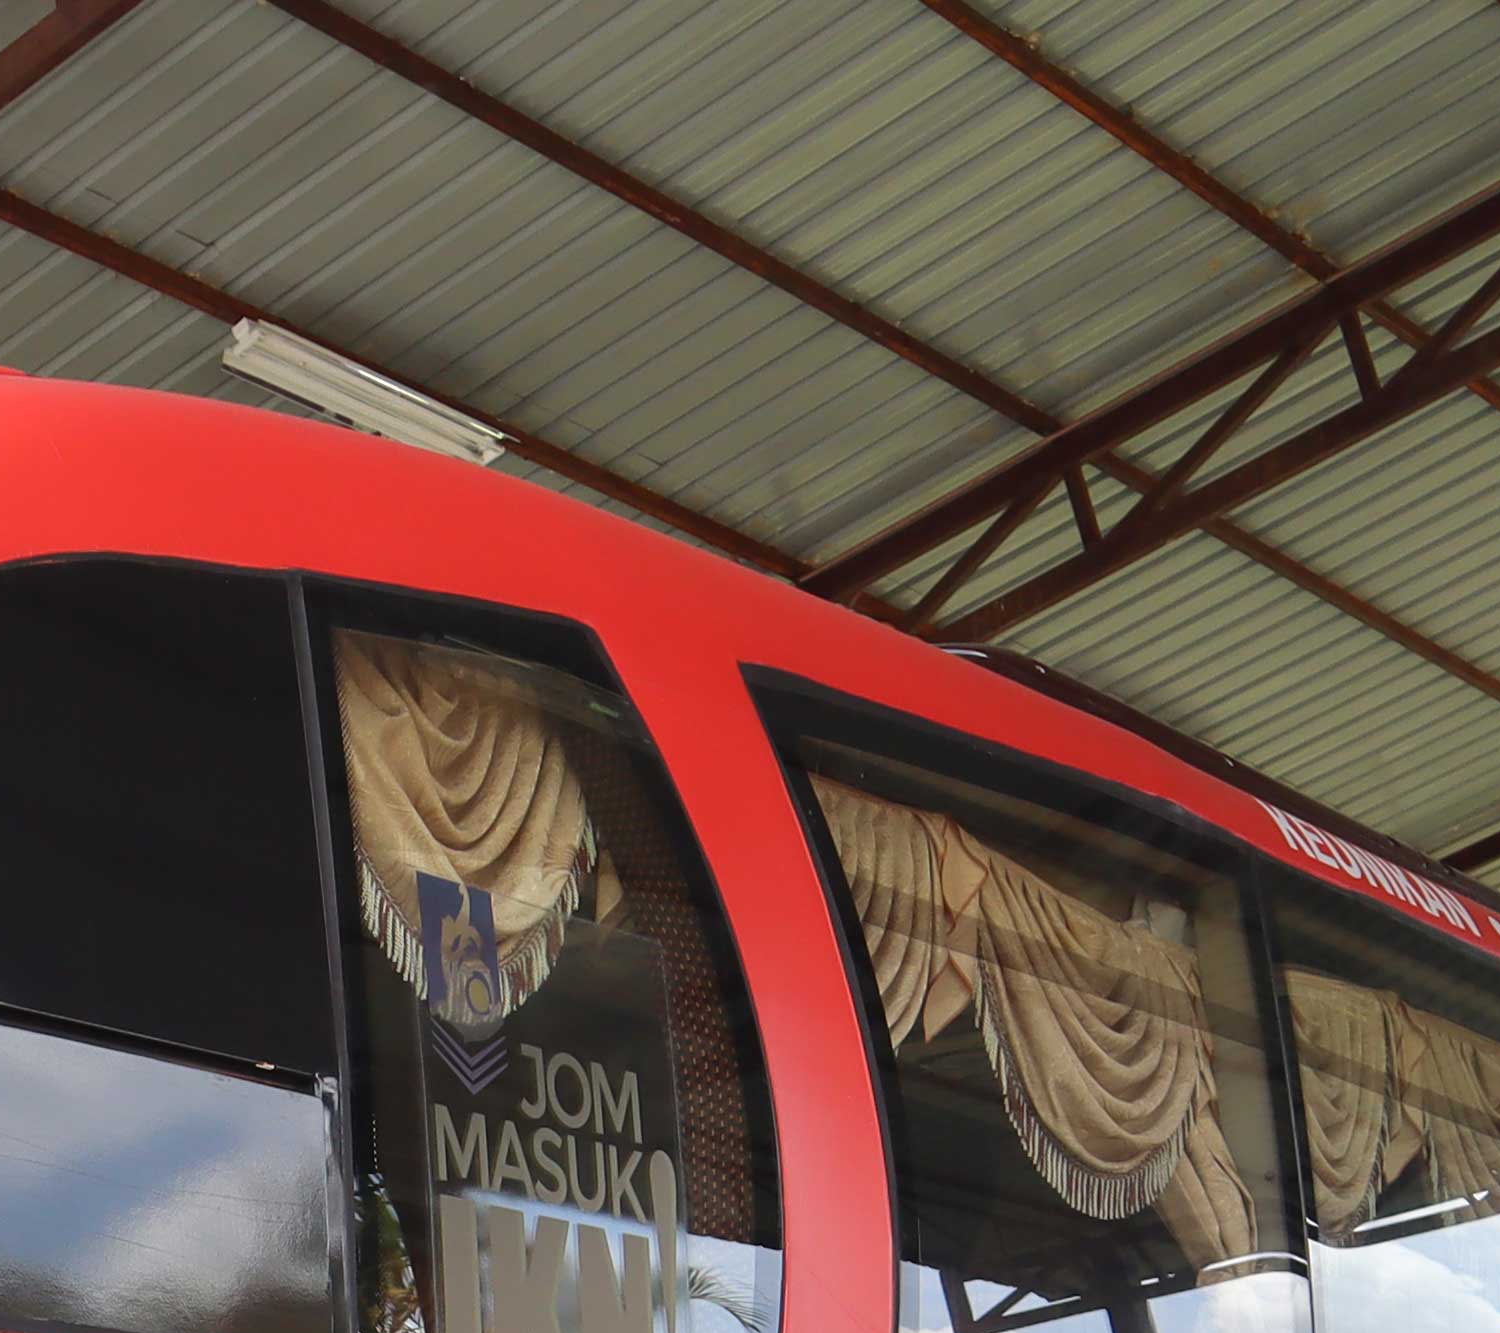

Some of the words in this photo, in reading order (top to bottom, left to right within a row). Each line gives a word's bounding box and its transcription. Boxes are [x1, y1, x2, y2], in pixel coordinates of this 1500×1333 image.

[1253, 797, 1481, 937] KEUNIKAN
[519, 1042, 643, 1145] JOM
[433, 1102, 648, 1222] MASUK
